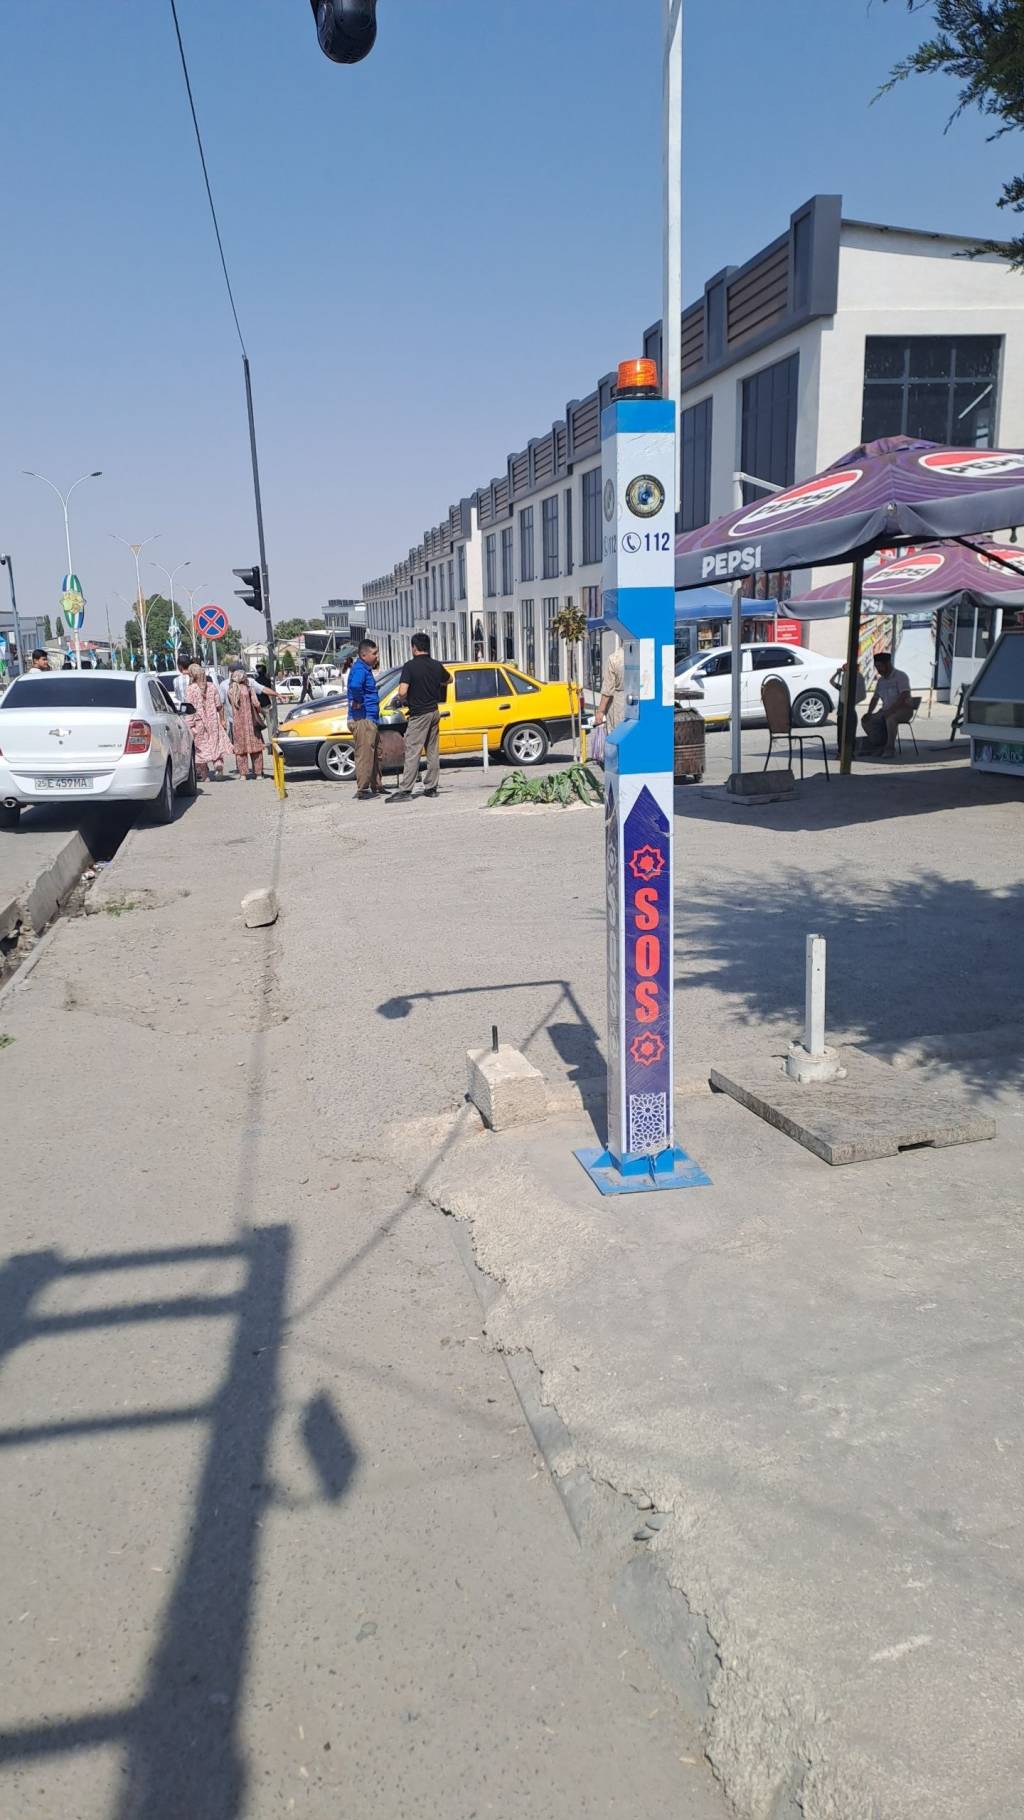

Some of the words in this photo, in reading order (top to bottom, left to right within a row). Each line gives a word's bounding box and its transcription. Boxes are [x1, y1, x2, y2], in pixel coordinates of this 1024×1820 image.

[747, 485, 848, 519] PEPSI
[644, 532, 670, 551] 112
[701, 545, 762, 579] PEPSI
[844, 599, 884, 614] PSI
[634, 887, 661, 1024] SOS
